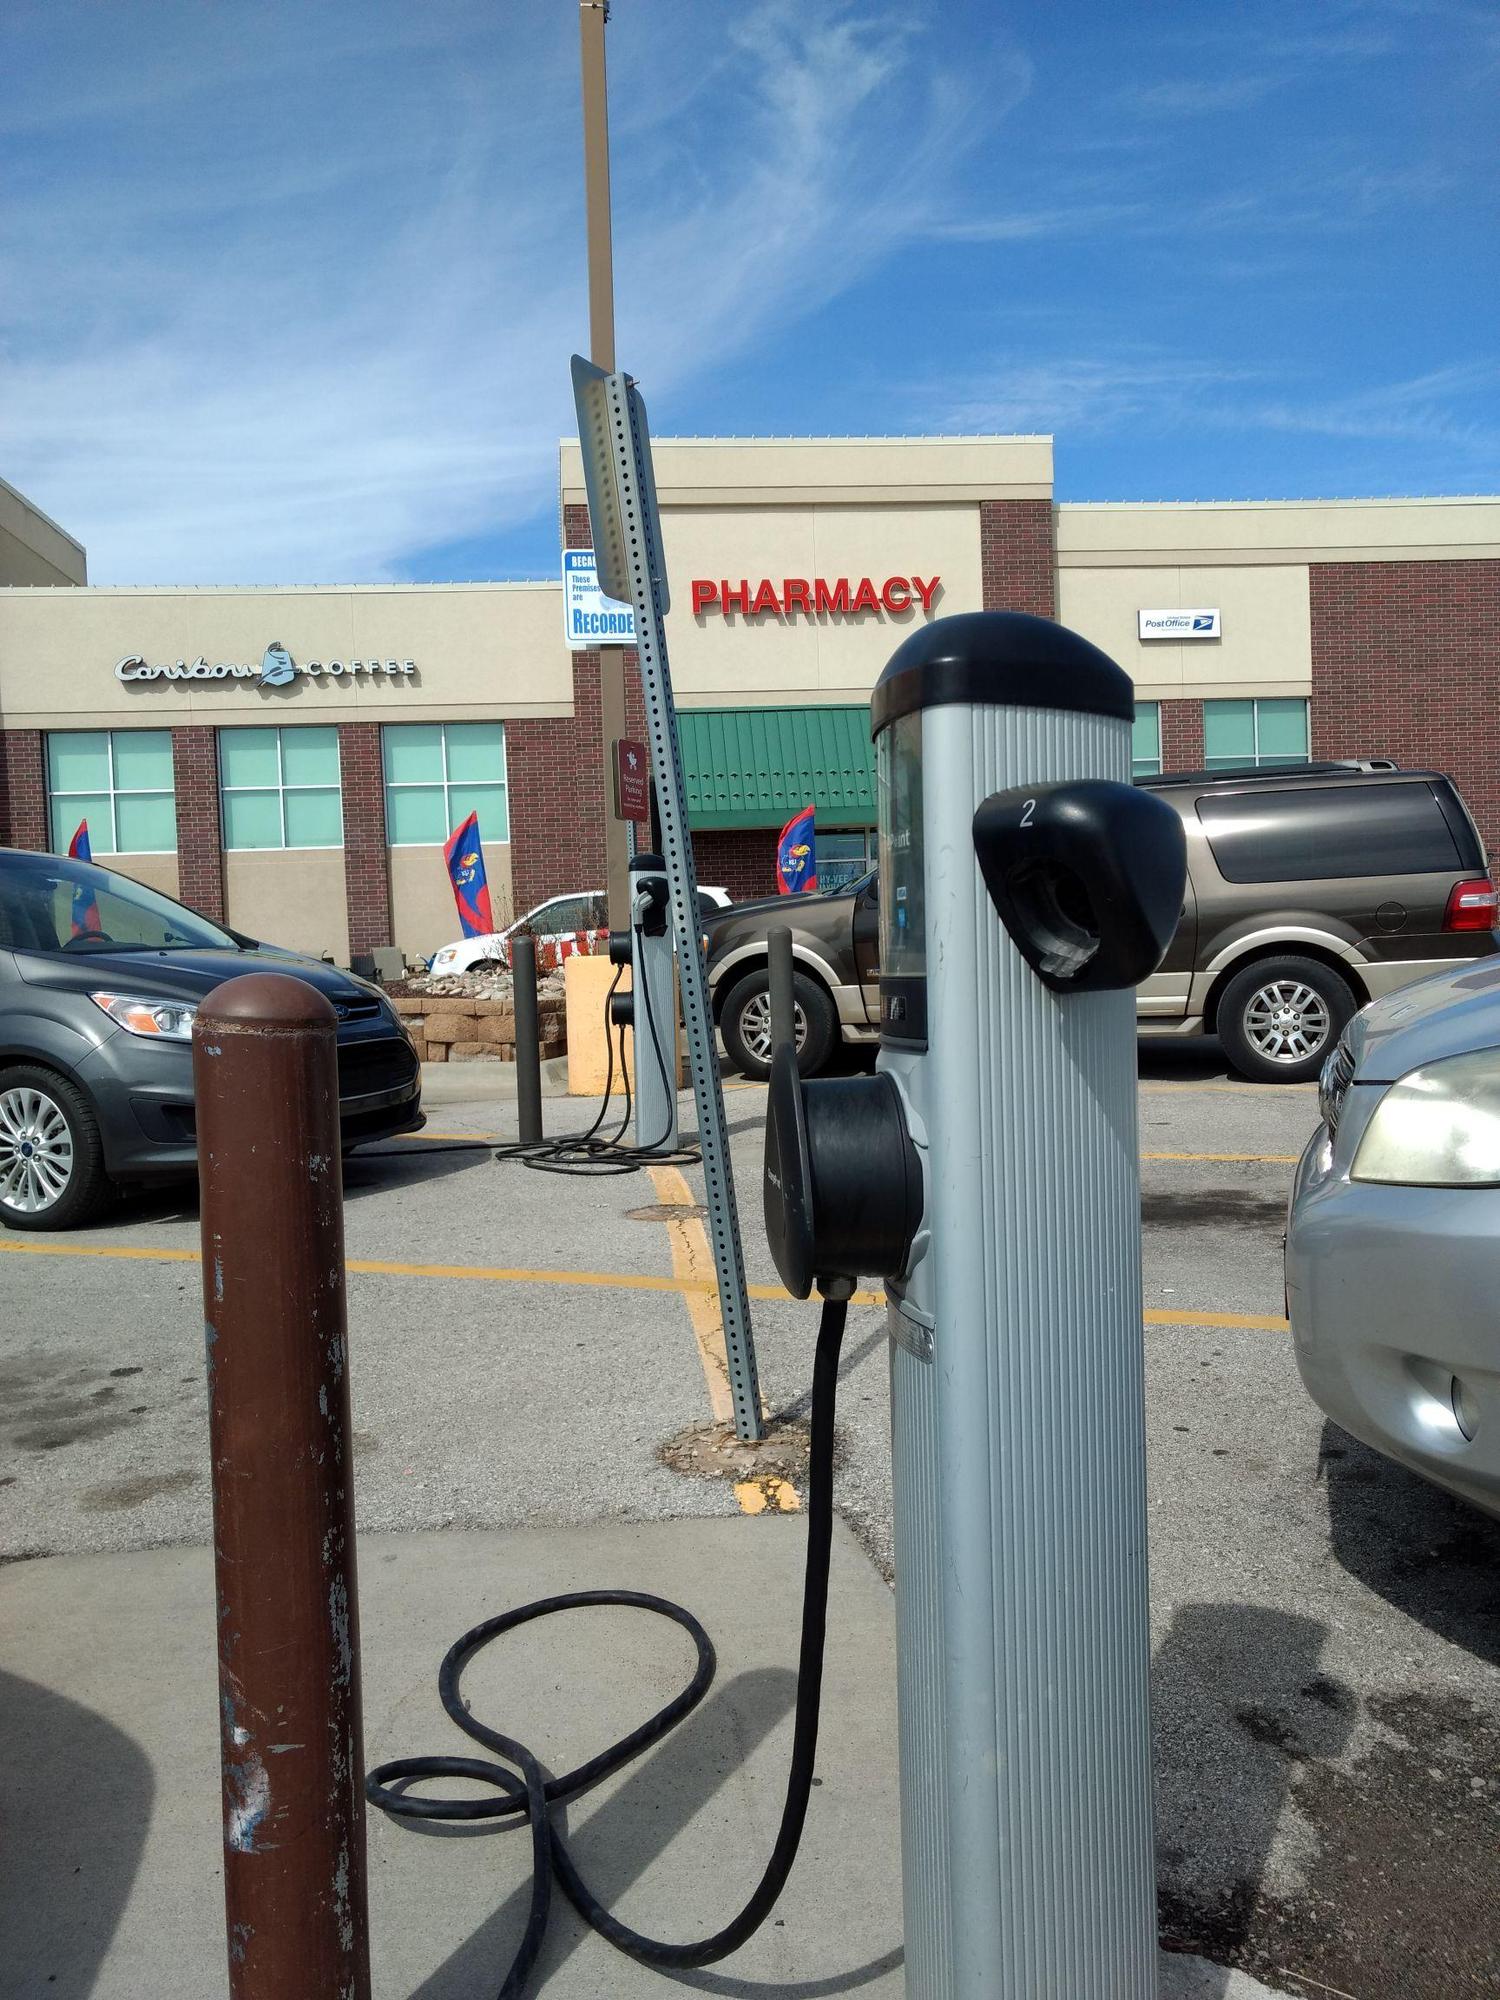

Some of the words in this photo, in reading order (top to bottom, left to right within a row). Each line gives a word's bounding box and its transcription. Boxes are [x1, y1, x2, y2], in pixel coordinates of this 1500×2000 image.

[571, 556, 597, 567] BECAU
[572, 575, 590, 583] These
[691, 576, 941, 614] PHARMACY
[573, 609, 634, 633] RECORDE
[1145, 620, 1164, 628] Post
[1165, 619, 1190, 627] Office
[114, 655, 253, 681] Caribou
[306, 659, 415, 676] COFFEE
[1020, 799, 1036, 827] 2
[820, 875, 848, 884] HY-VEE
